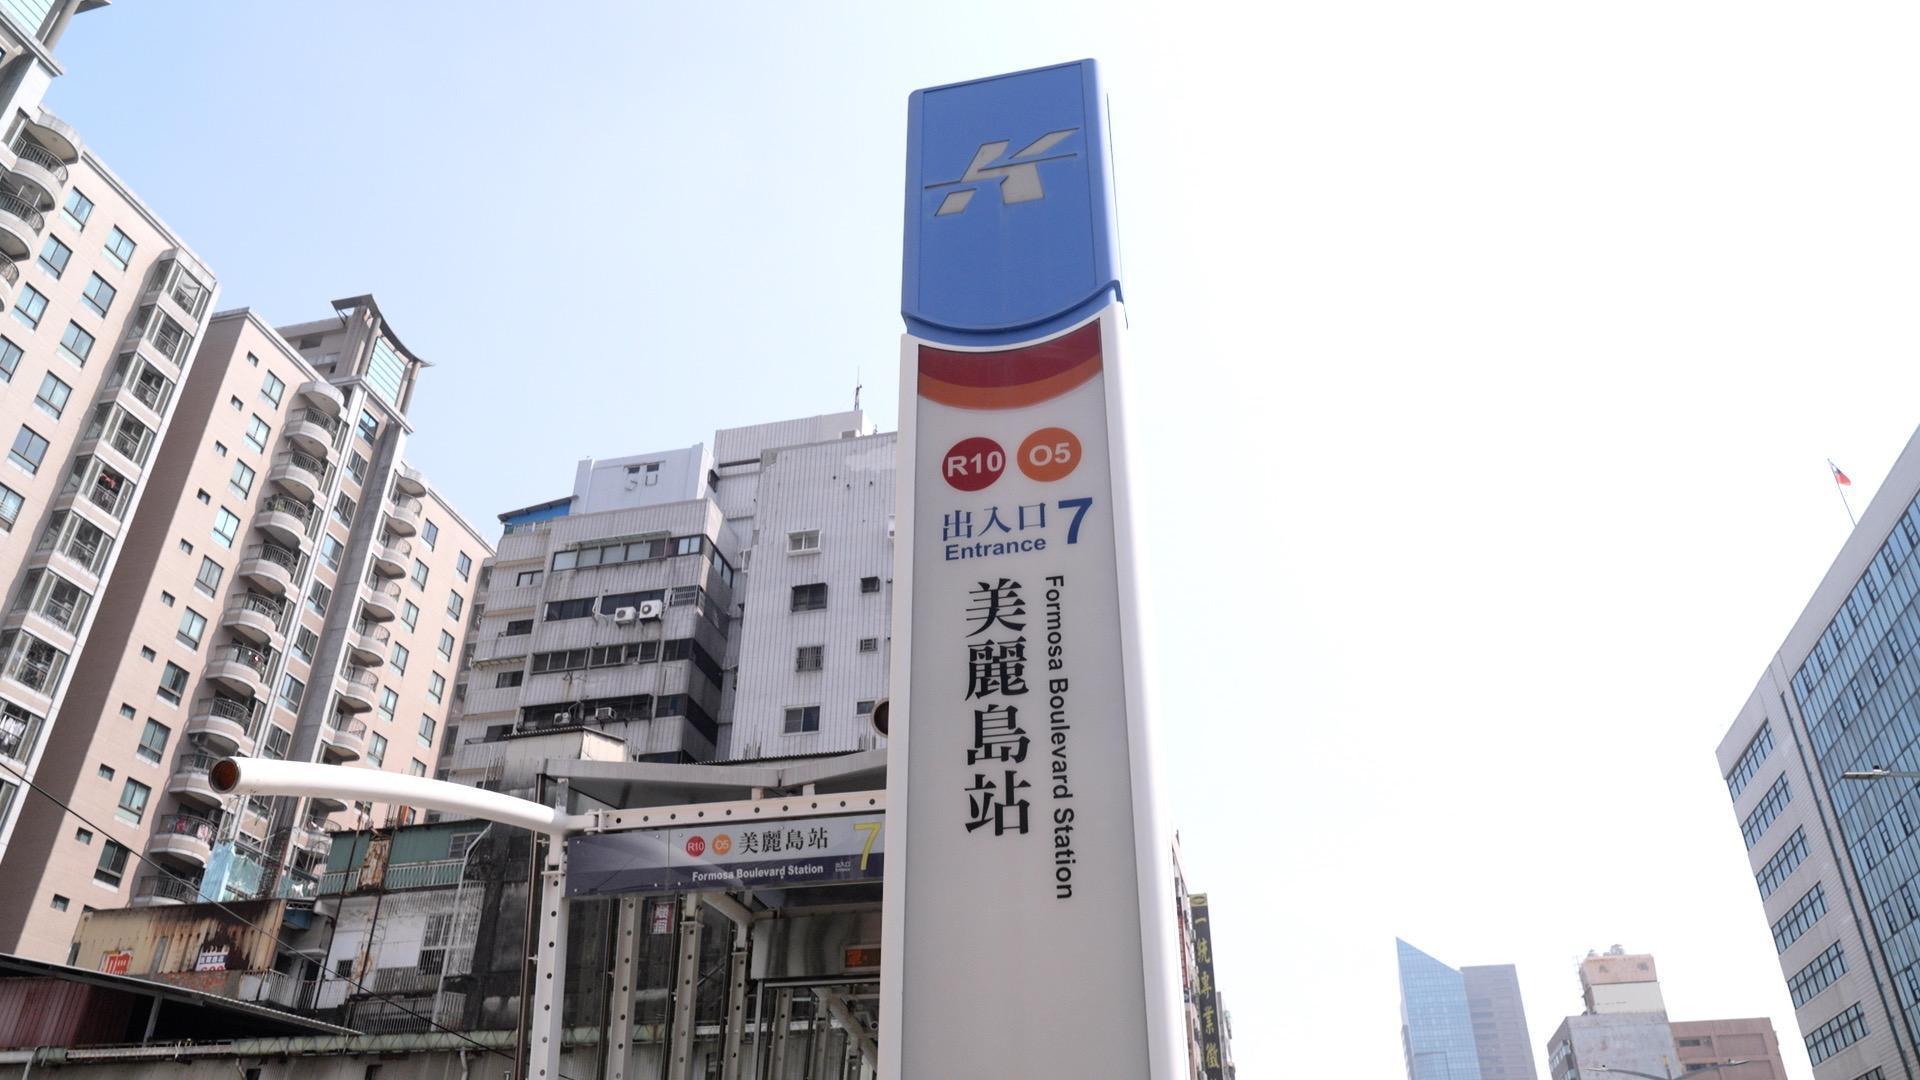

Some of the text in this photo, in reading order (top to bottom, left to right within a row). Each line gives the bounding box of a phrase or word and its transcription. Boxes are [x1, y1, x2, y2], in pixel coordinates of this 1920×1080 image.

[947, 450, 1004, 478] R10
[942, 497, 1093, 545] 出入口 7
[945, 537, 1047, 561] Entrance
[965, 577, 1032, 837] 美麗島站
[1045, 575, 1076, 899] Formosa Boulevard Station
[687, 840, 705, 852] R10
[738, 827, 829, 855] 美麗島站
[853, 821, 881, 871] 7
[692, 869, 735, 882] Formosa
[736, 866, 786, 880] Boulevard
[787, 864, 824, 877] Station
